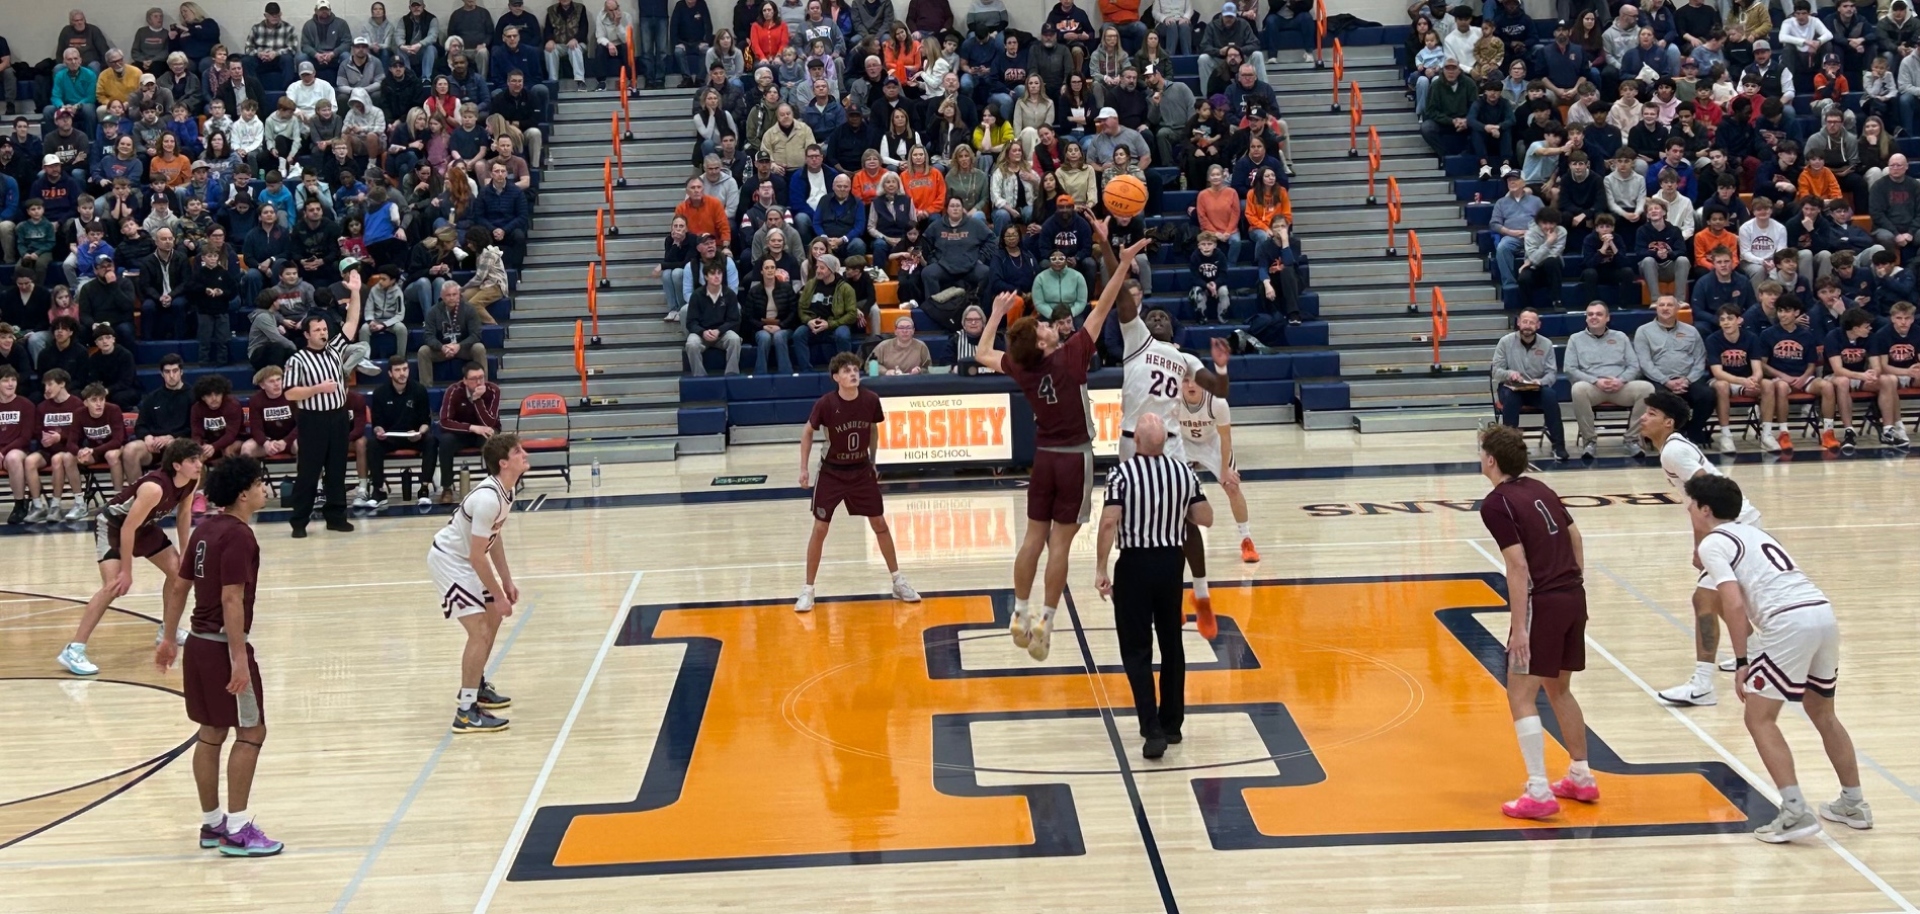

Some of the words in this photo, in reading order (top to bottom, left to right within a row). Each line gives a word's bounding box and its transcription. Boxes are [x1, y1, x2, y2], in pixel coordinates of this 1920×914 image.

[1037, 374, 1058, 404] 4
[1148, 370, 1178, 398] 20
[910, 400, 951, 409] WELCOME
[952, 399, 962, 407] TO
[847, 432, 860, 452] 0
[1190, 429, 1202, 438] 5
[904, 450, 928, 461] HIGH
[931, 448, 972, 460] SCHOOL
[1534, 499, 1558, 536] 1
[194, 540, 207, 578] 2
[1761, 543, 1795, 573] 0
